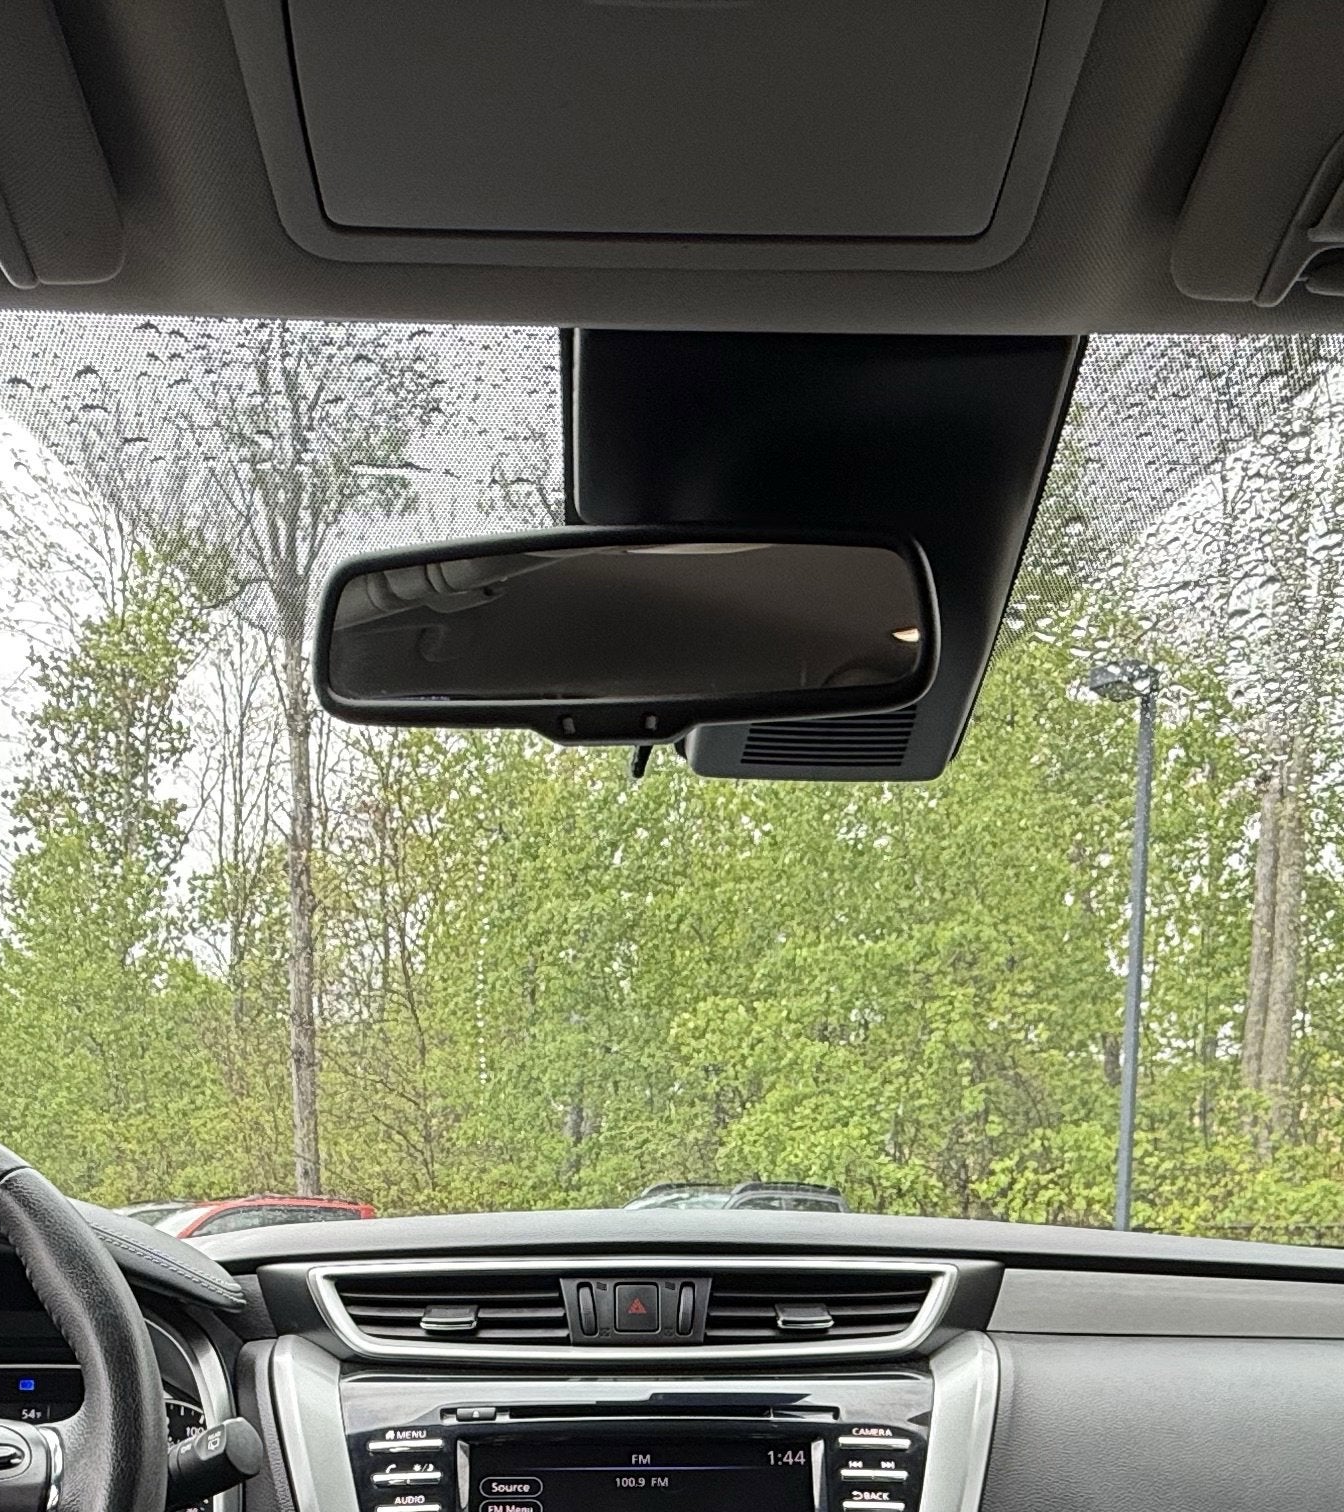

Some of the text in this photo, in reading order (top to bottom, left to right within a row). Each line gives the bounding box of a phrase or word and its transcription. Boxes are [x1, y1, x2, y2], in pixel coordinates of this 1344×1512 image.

[396, 1430, 427, 1439] MENU
[851, 1427, 893, 1437] CAMERA
[631, 1454, 651, 1465] FM
[767, 1450, 806, 1466] 1:44
[491, 1482, 531, 1492] Source
[615, 1477, 669, 1488] 100.9 FM
[394, 1495, 426, 1504] AUDIO
[864, 1491, 890, 1500] BACK
